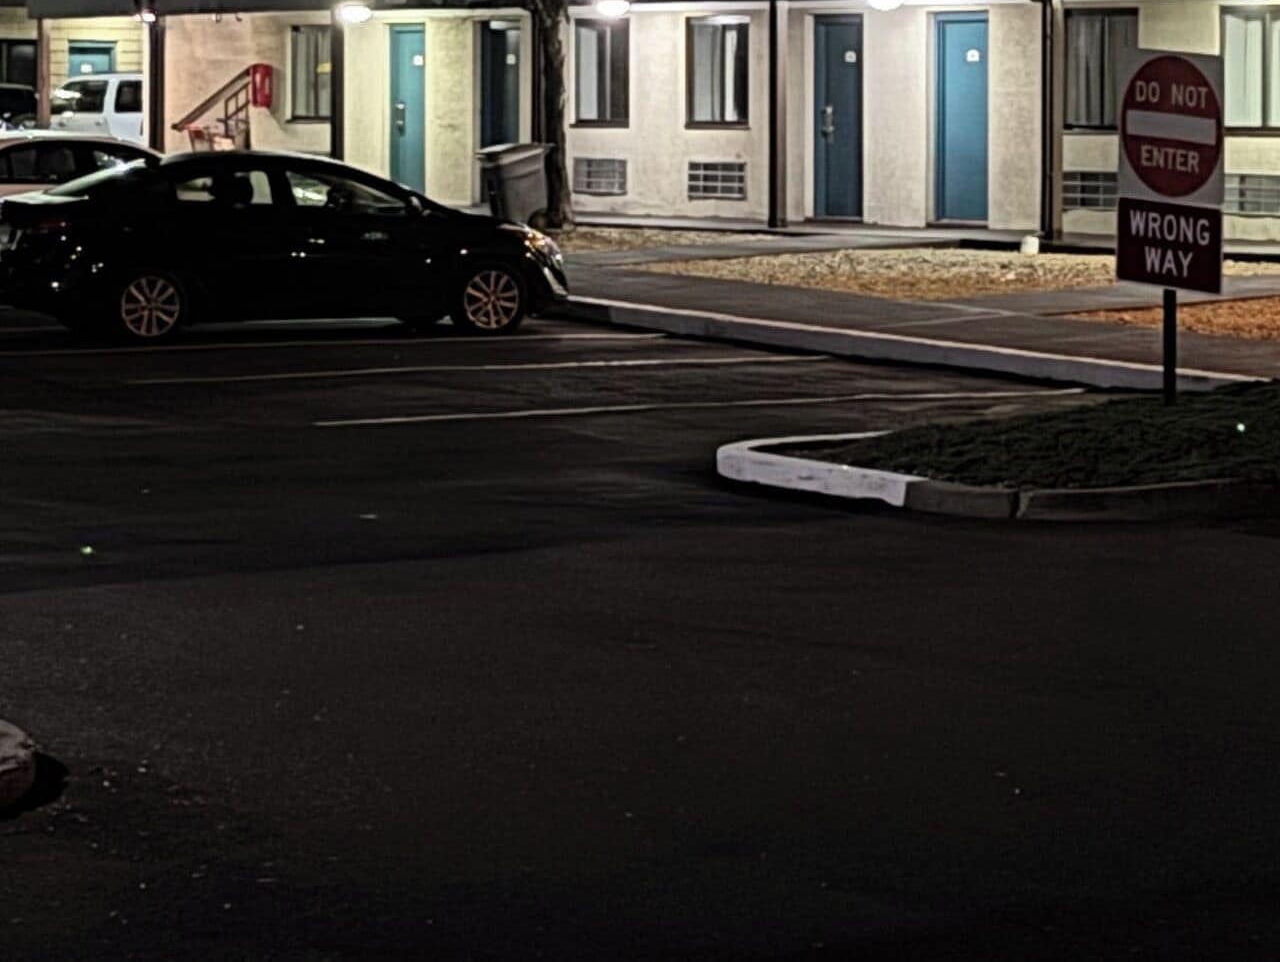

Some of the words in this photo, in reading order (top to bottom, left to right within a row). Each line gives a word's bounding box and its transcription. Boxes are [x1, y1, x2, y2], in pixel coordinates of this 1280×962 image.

[1135, 81, 1160, 103] DO
[1171, 83, 1208, 109] NOT
[1141, 145, 1200, 174] ENTER
[1129, 209, 1210, 246] WRONG
[1144, 245, 1193, 278] WAY
